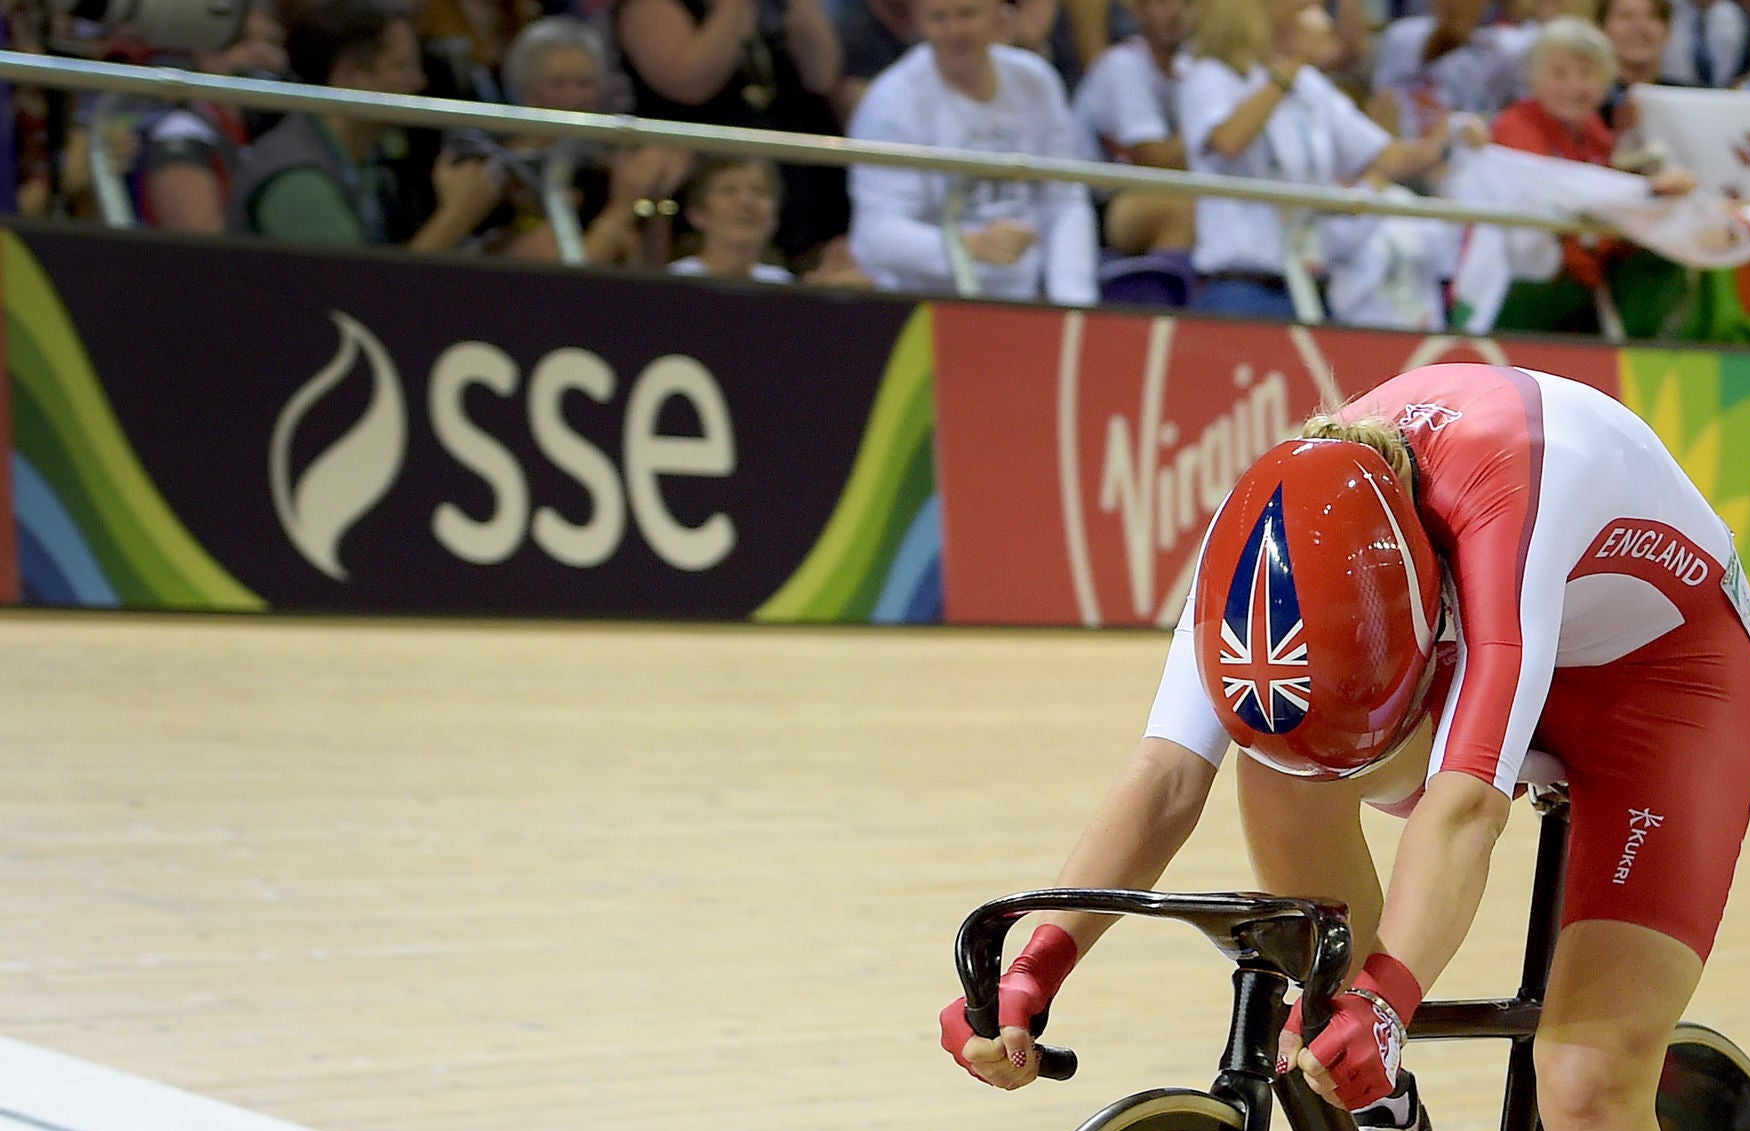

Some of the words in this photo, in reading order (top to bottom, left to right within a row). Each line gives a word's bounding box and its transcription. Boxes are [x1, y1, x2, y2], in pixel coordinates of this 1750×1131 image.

[428, 339, 738, 571] sse
[1100, 318, 1297, 617] Virgin
[1595, 527, 1709, 587] ENGLAND
[1612, 828, 1648, 885] KUKRI
